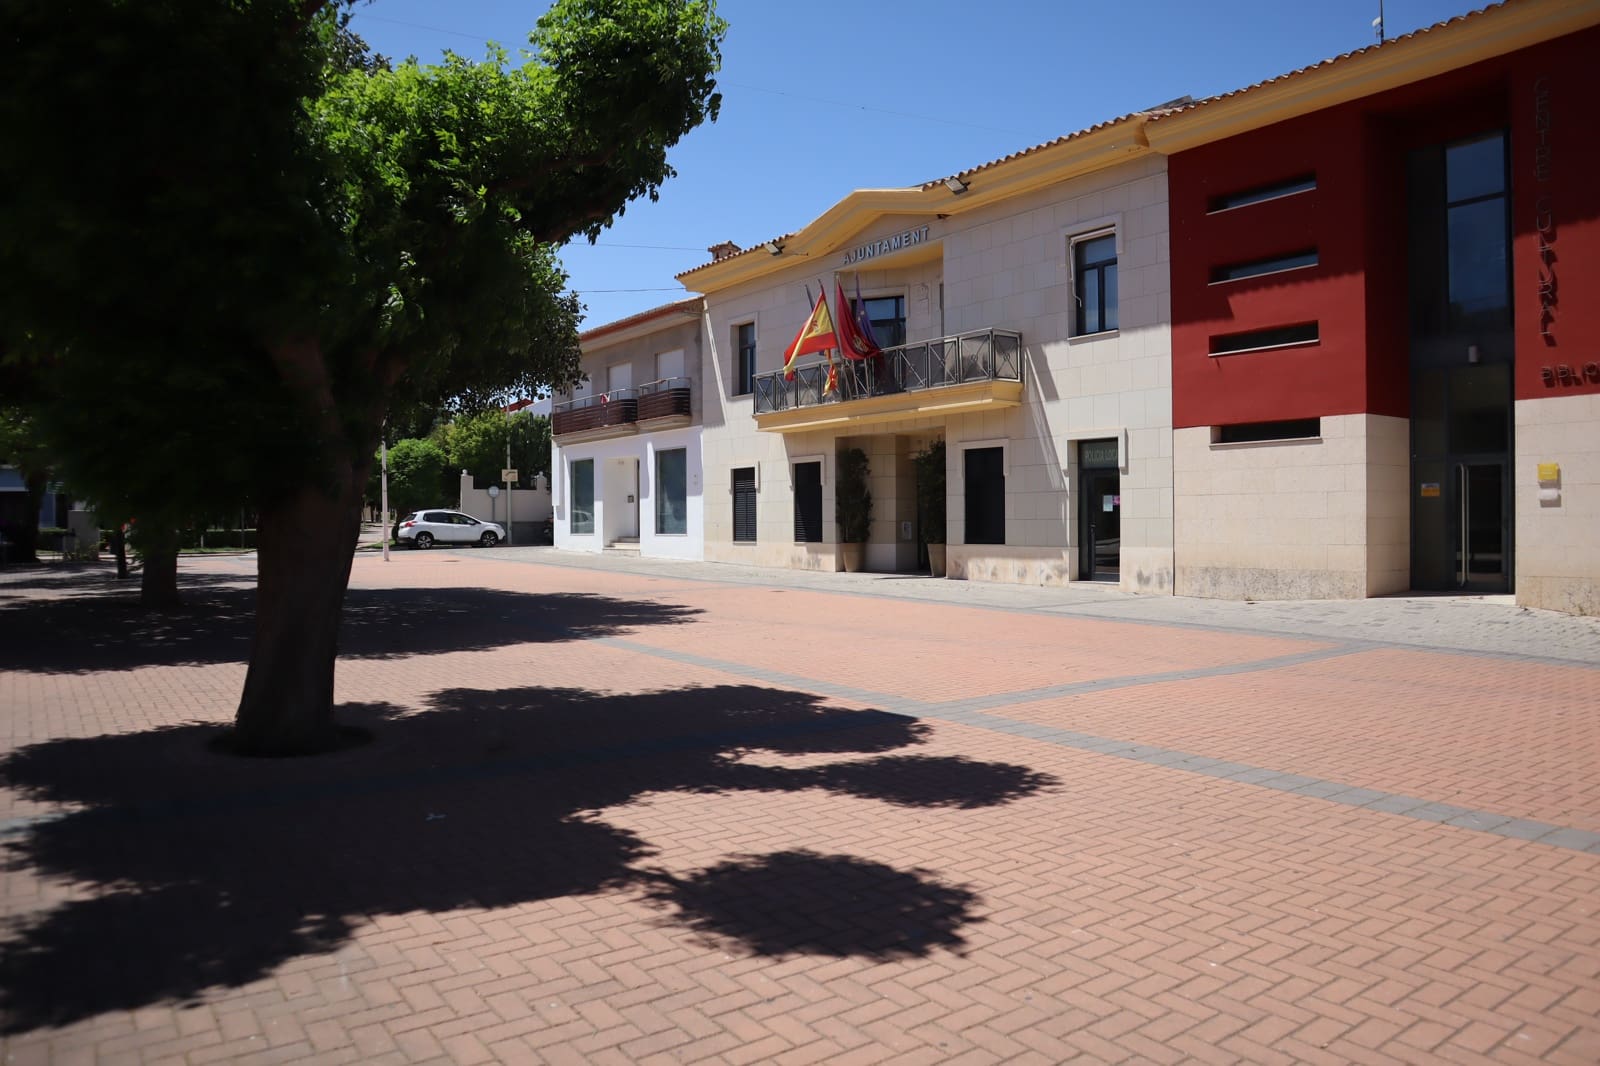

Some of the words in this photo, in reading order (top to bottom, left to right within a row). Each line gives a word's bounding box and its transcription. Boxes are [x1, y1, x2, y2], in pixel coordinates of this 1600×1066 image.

[843, 226, 929, 265] AJUNTAMENT
[1536, 196, 1553, 336] CULTURAL
[1541, 361, 1600, 381] BIBLIO
